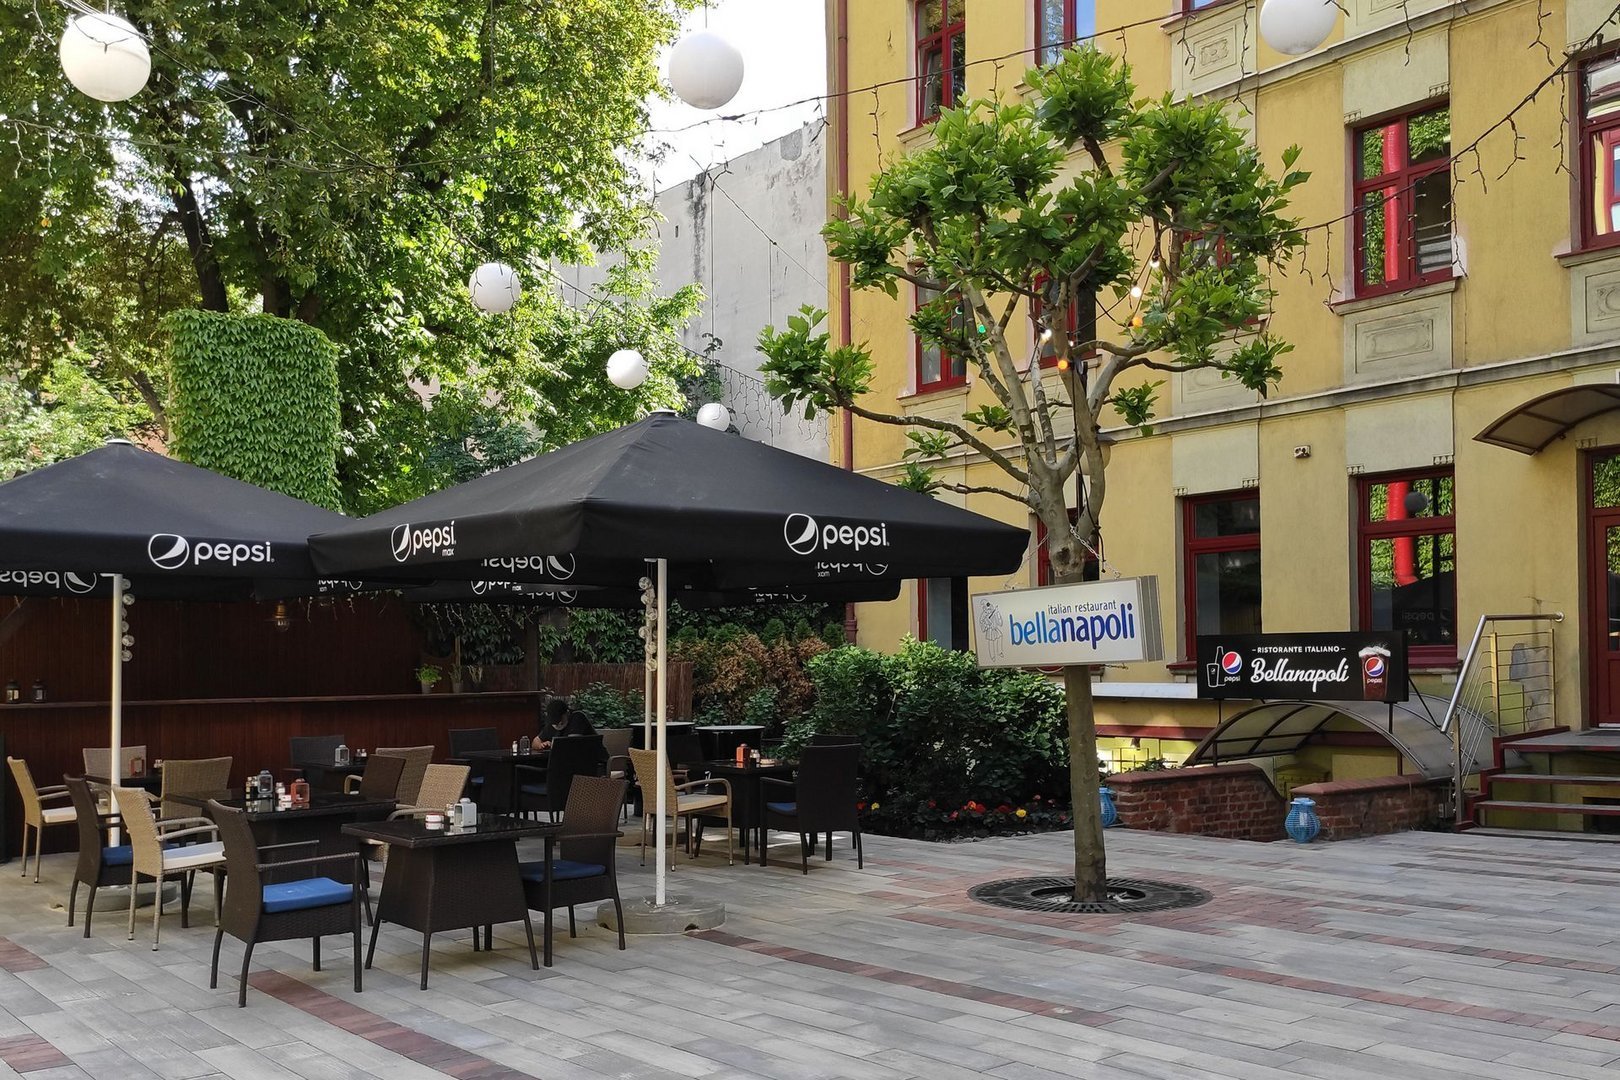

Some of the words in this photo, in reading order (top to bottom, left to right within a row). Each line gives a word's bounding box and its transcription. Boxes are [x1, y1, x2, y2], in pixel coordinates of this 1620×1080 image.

[413, 520, 457, 556] pepsi
[822, 522, 888, 551] pepsi
[194, 540, 273, 567] pepsi
[441, 547, 455, 557] max
[1047, 603, 1072, 615] italian
[1074, 600, 1117, 613] restaurant
[1009, 602, 1135, 650] bellanapoli
[1257, 646, 1303, 654] RISTORANTE
[1304, 645, 1340, 653] ITALIANO
[1223, 675, 1241, 683] pepsi
[1250, 657, 1350, 693] Bellanapoli
